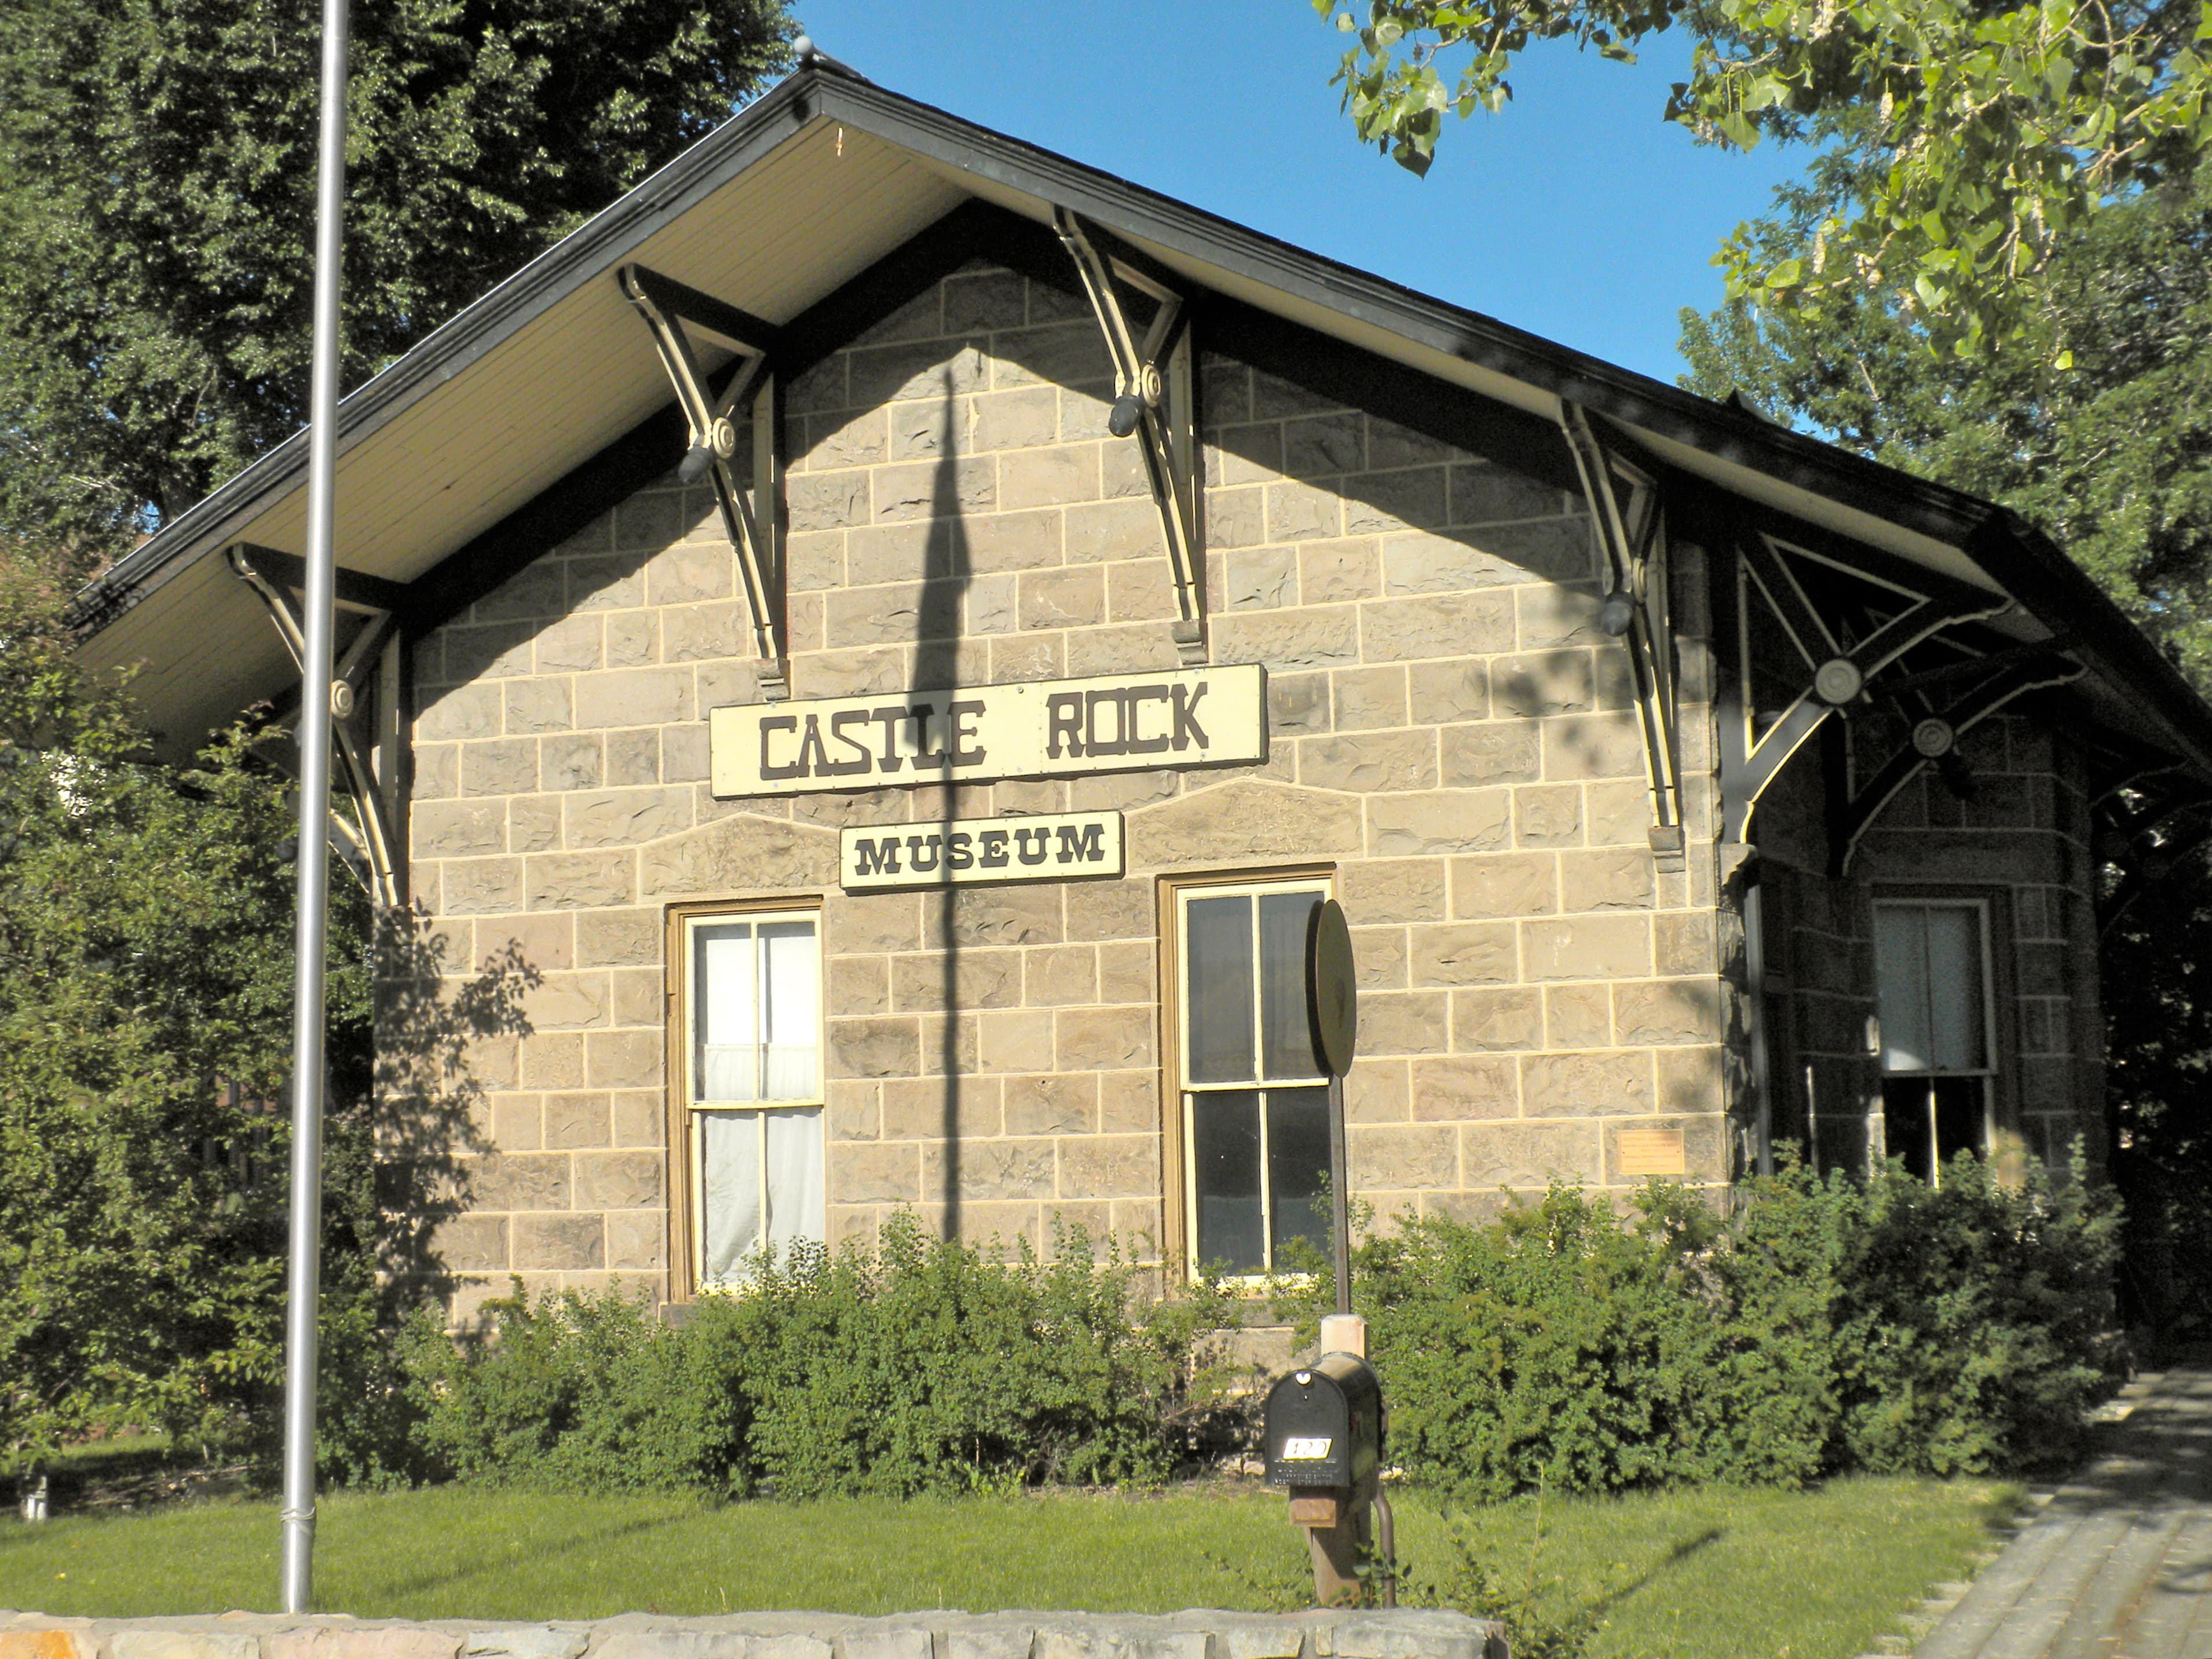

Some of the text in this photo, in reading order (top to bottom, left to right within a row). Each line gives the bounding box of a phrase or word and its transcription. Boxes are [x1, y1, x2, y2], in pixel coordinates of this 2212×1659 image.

[760, 682, 1209, 780] CASTLE ROCK
[854, 824, 1105, 875] MUSEUM
[1293, 1441, 1327, 1456] 120
